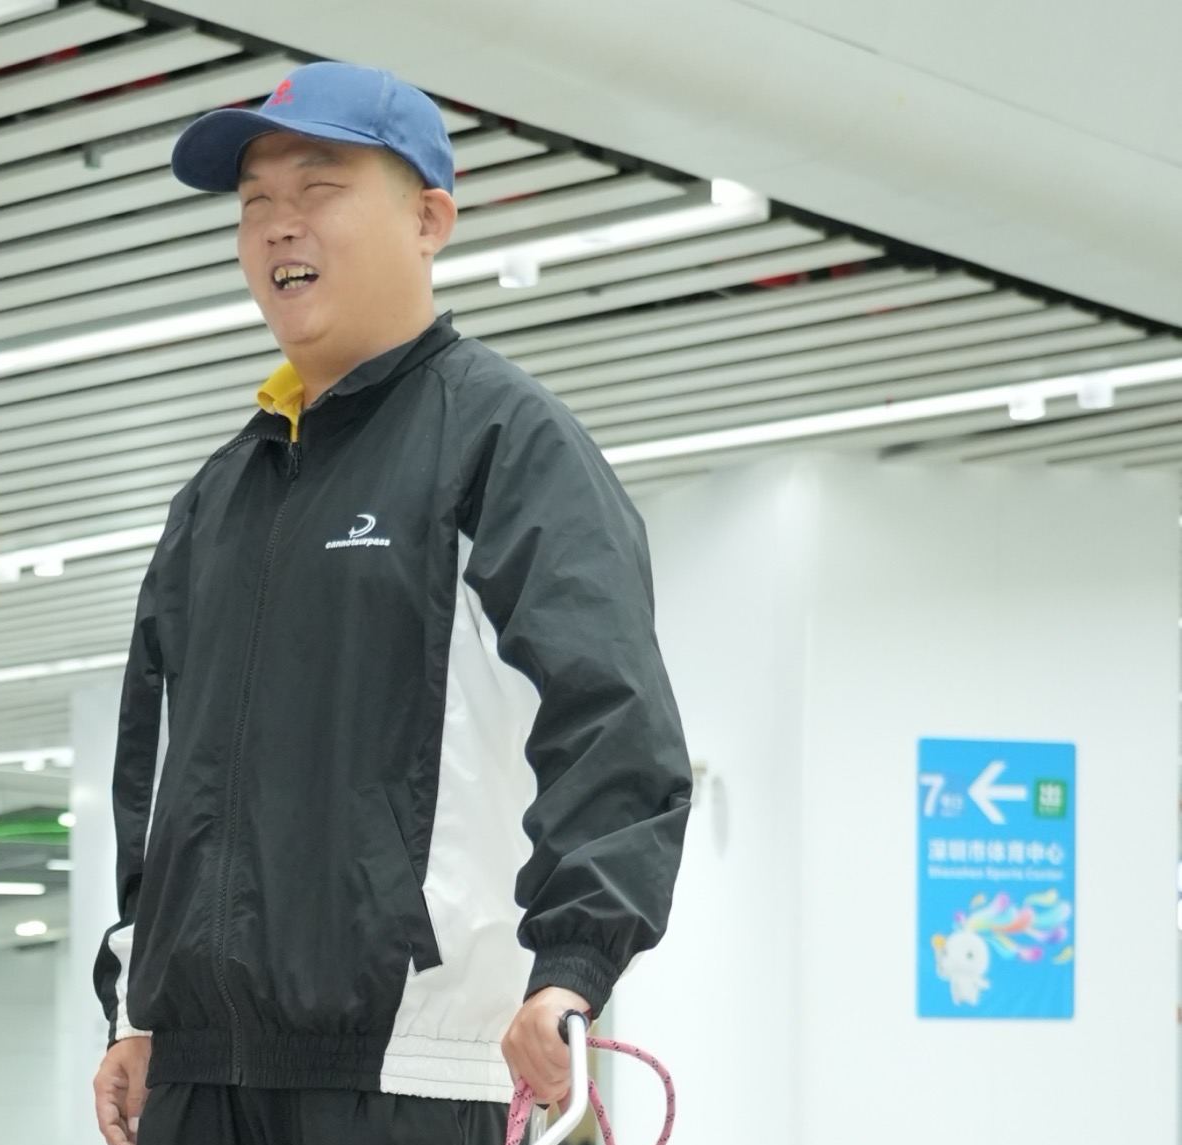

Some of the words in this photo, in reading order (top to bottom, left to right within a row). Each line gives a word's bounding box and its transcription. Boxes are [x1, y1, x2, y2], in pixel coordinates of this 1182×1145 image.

[928, 838, 1064, 866] 深圳市体育中心
